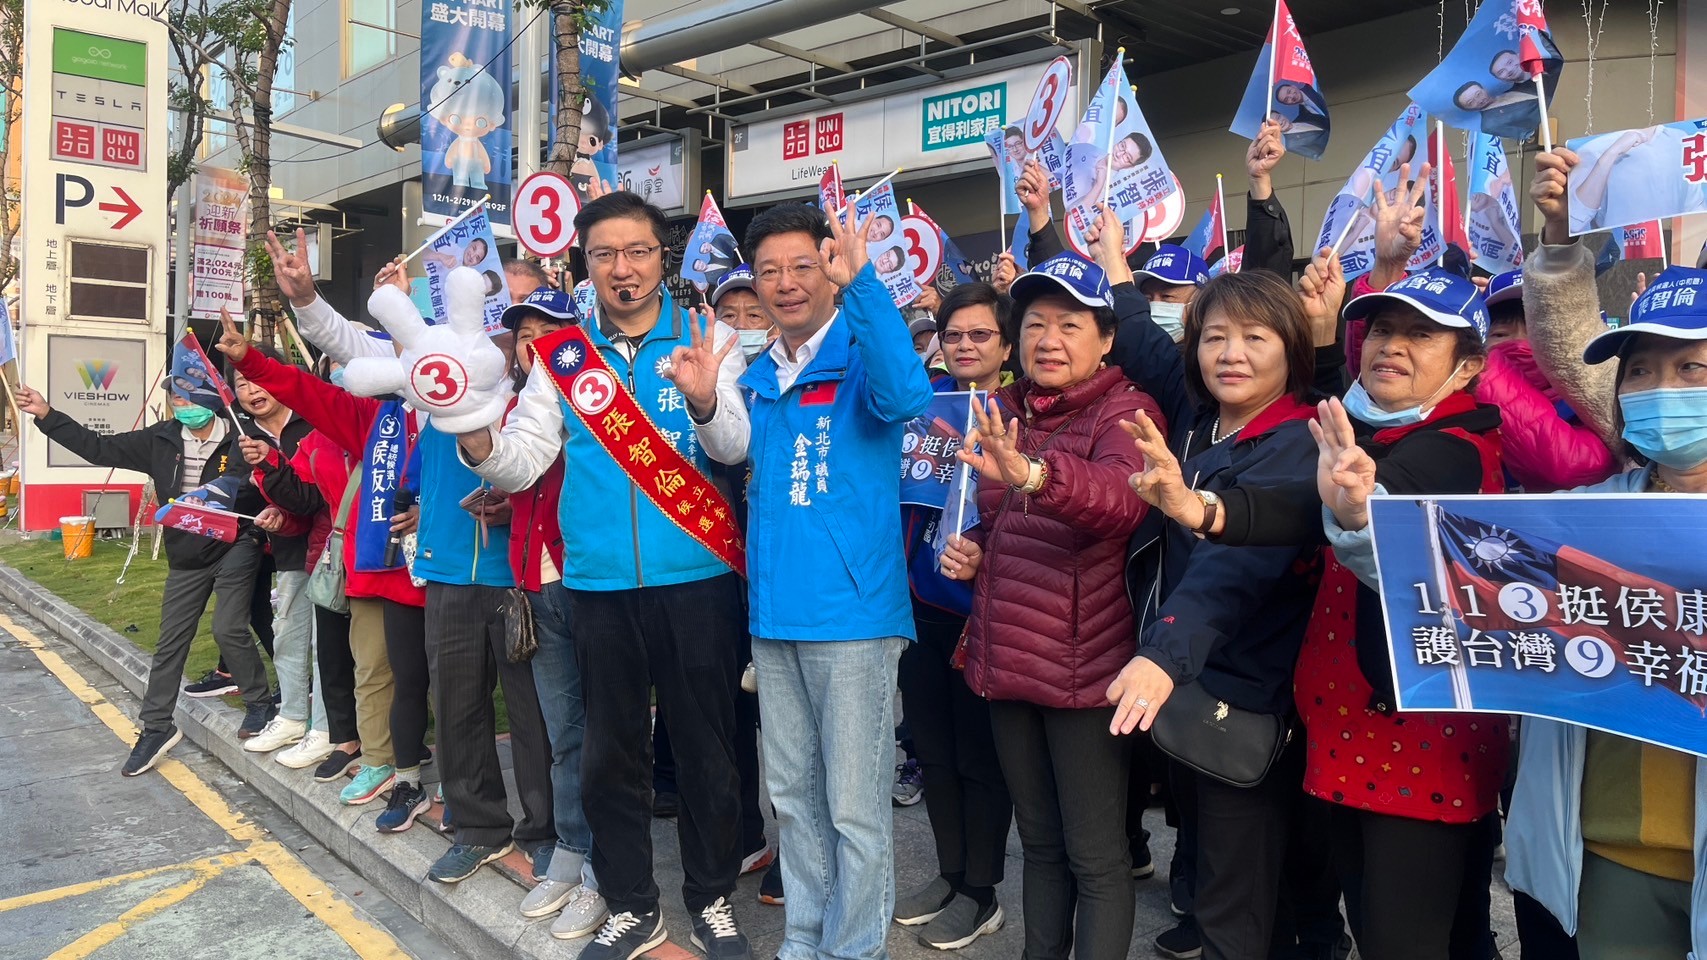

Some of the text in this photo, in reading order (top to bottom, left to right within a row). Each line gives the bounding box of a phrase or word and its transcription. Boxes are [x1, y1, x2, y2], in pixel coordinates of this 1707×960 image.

[430, 3, 505, 32] 盛大開幕
[583, 24, 614, 42] ART
[56, 90, 142, 111] TESLA
[927, 88, 1001, 122] NITORI
[1032, 73, 1058, 138] 3
[106, 132, 134, 146] UNI
[818, 119, 840, 134] UNI
[818, 133, 840, 151] QLO
[927, 114, 1001, 145] 宜得利家居
[107, 146, 136, 161] QLO
[56, 173, 95, 225] P
[199, 217, 242, 234] 祈願祭
[529, 186, 562, 247] 3
[45, 238, 58, 270] 地上層
[903, 228, 928, 279] 3
[45, 284, 58, 316] 地下層
[63, 391, 130, 401] VIESHOW
[419, 361, 458, 401] 3
[579, 376, 609, 407] 3
[381, 418, 396, 436] 3
[601, 406, 687, 498] 張智倫
[815, 415, 832, 494] 新北市議員
[370, 439, 390, 522] 侯友宜
[789, 432, 813, 507] 金瑞龍
[677, 499, 734, 552] 候選人
